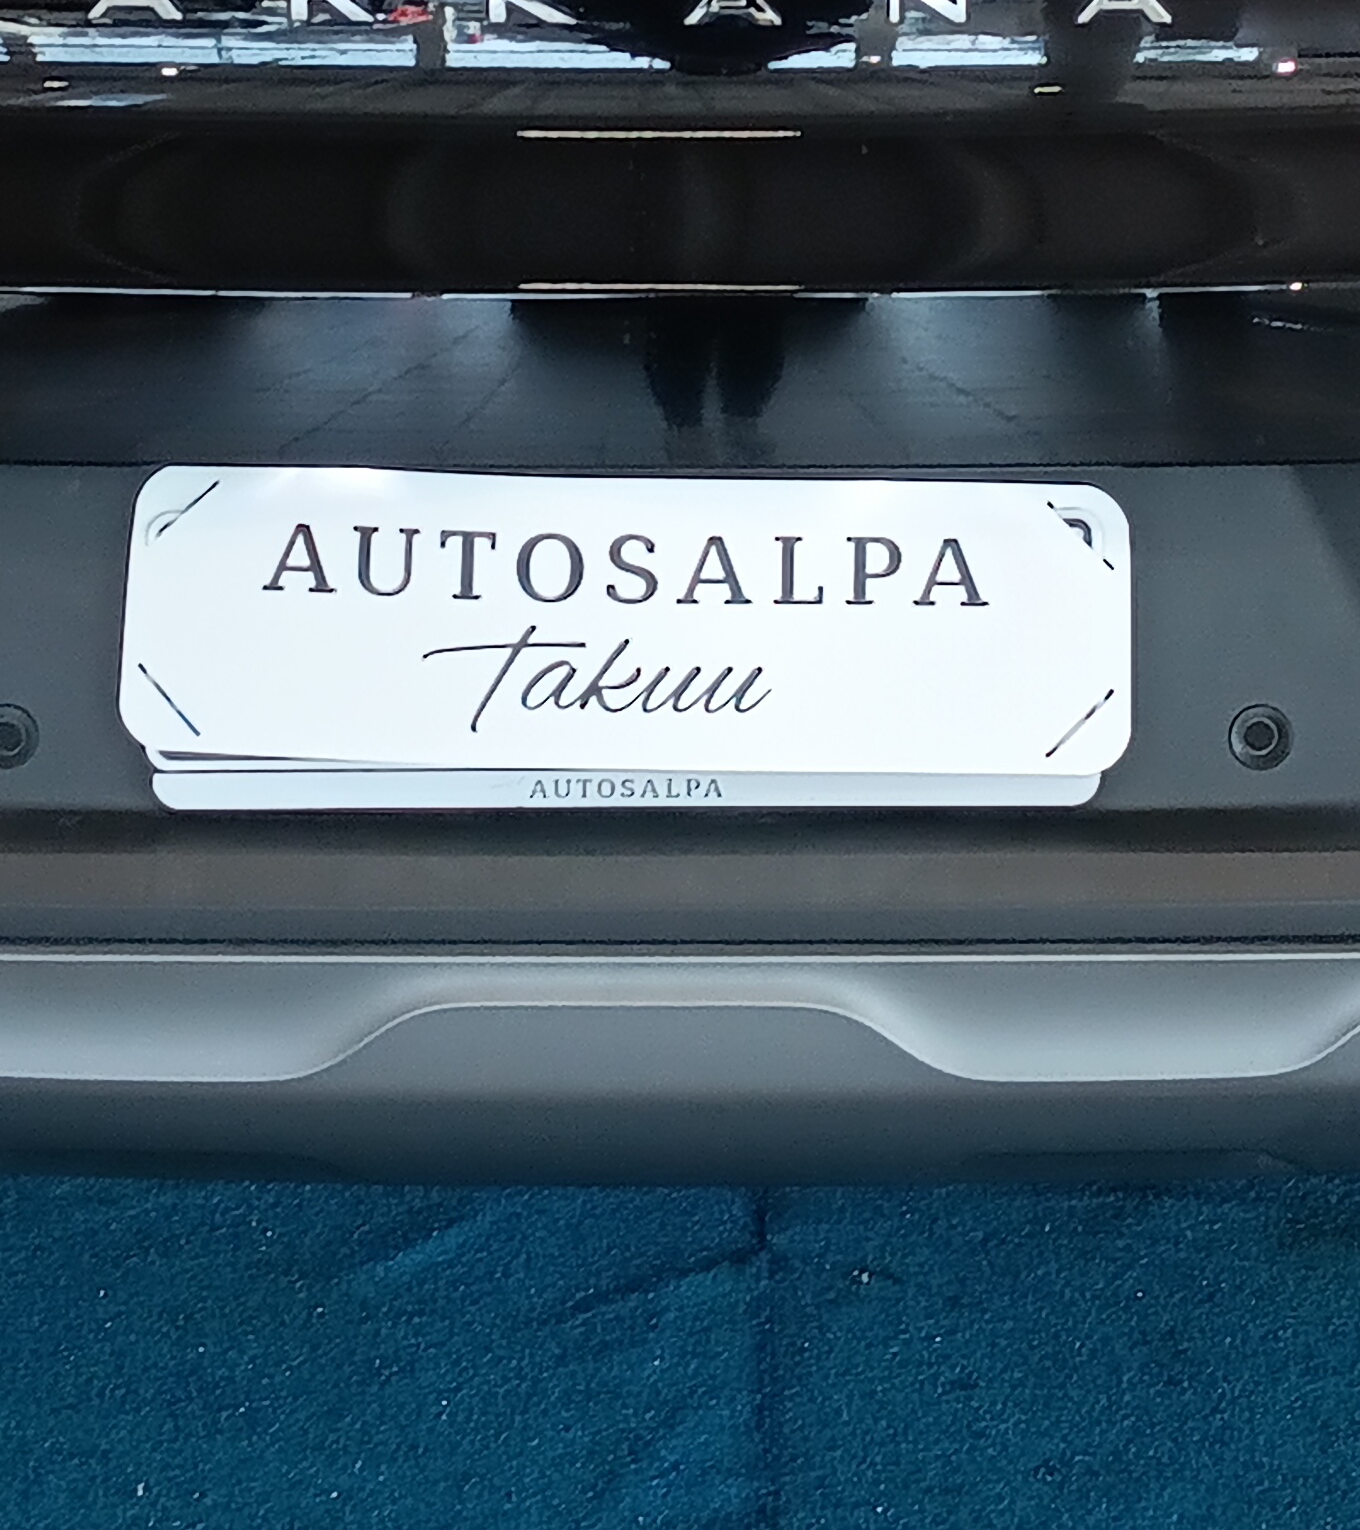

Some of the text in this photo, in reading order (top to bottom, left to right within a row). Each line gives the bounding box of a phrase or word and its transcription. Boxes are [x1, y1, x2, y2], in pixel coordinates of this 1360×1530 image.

[261, 523, 990, 608] AUTOSALPA
[422, 624, 772, 733] Takuu
[528, 775, 724, 800] AUTOSALPA
